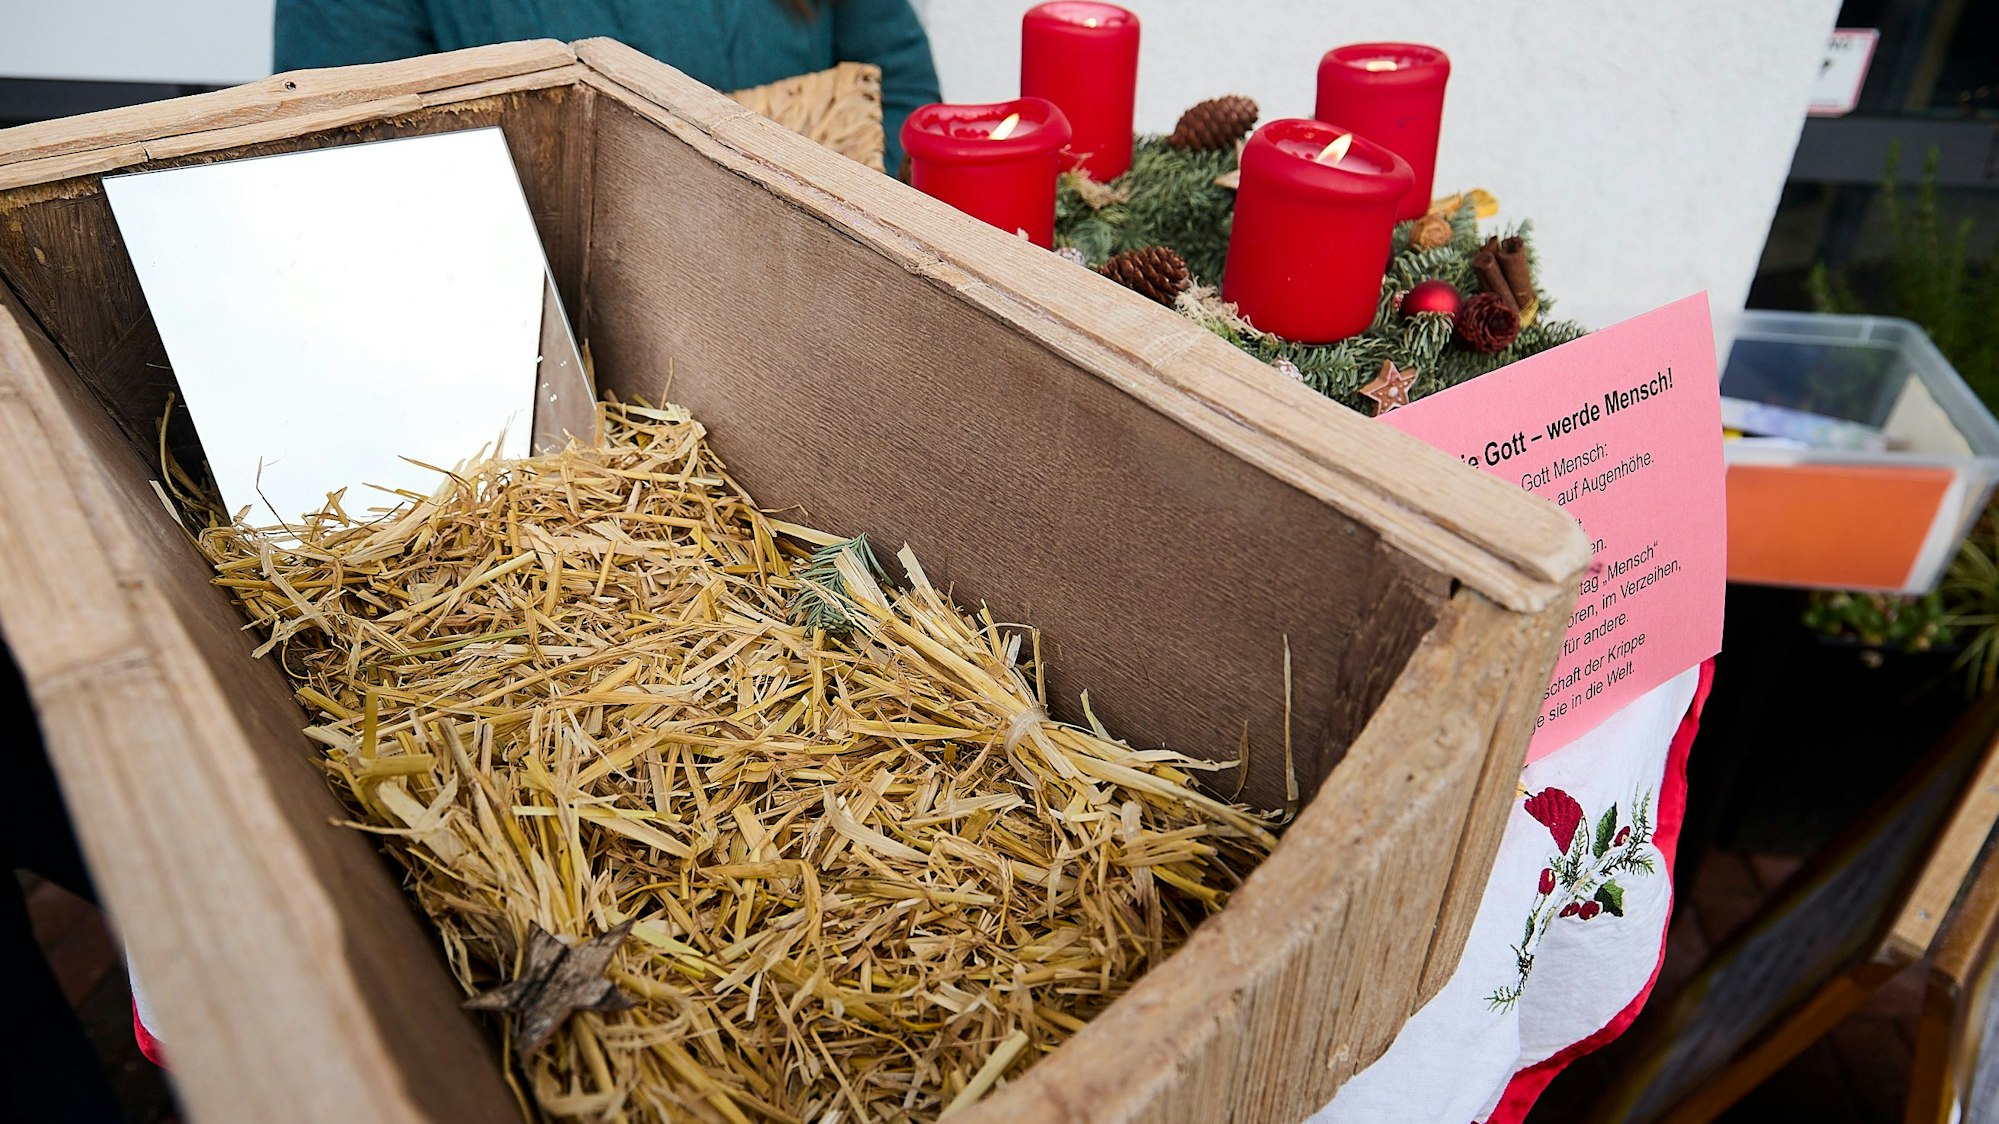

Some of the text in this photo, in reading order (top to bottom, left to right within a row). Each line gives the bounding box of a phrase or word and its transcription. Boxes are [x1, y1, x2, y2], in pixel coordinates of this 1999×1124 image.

[1484, 431, 1527, 466] Gott
[1530, 433, 1543, 442] –
[1546, 402, 1601, 440] werde
[1604, 367, 1674, 416] Mensch!
[1521, 442, 1608, 492] Gott Mensch:
[1557, 451, 1655, 506] auf Augenhöhe.
[1579, 541, 1659, 596] tag „Mensch“
[1602, 593, 1617, 610] im
[1620, 559, 1682, 599] Verzeihen,
[1563, 611, 1629, 656] für andere.
[1584, 655, 1605, 677] der
[1607, 632, 1646, 664] Krippe
[1549, 701, 1568, 721] sie
[1571, 693, 1582, 709] in
[1585, 681, 1604, 700] die
[1606, 660, 1635, 687] Welt.
